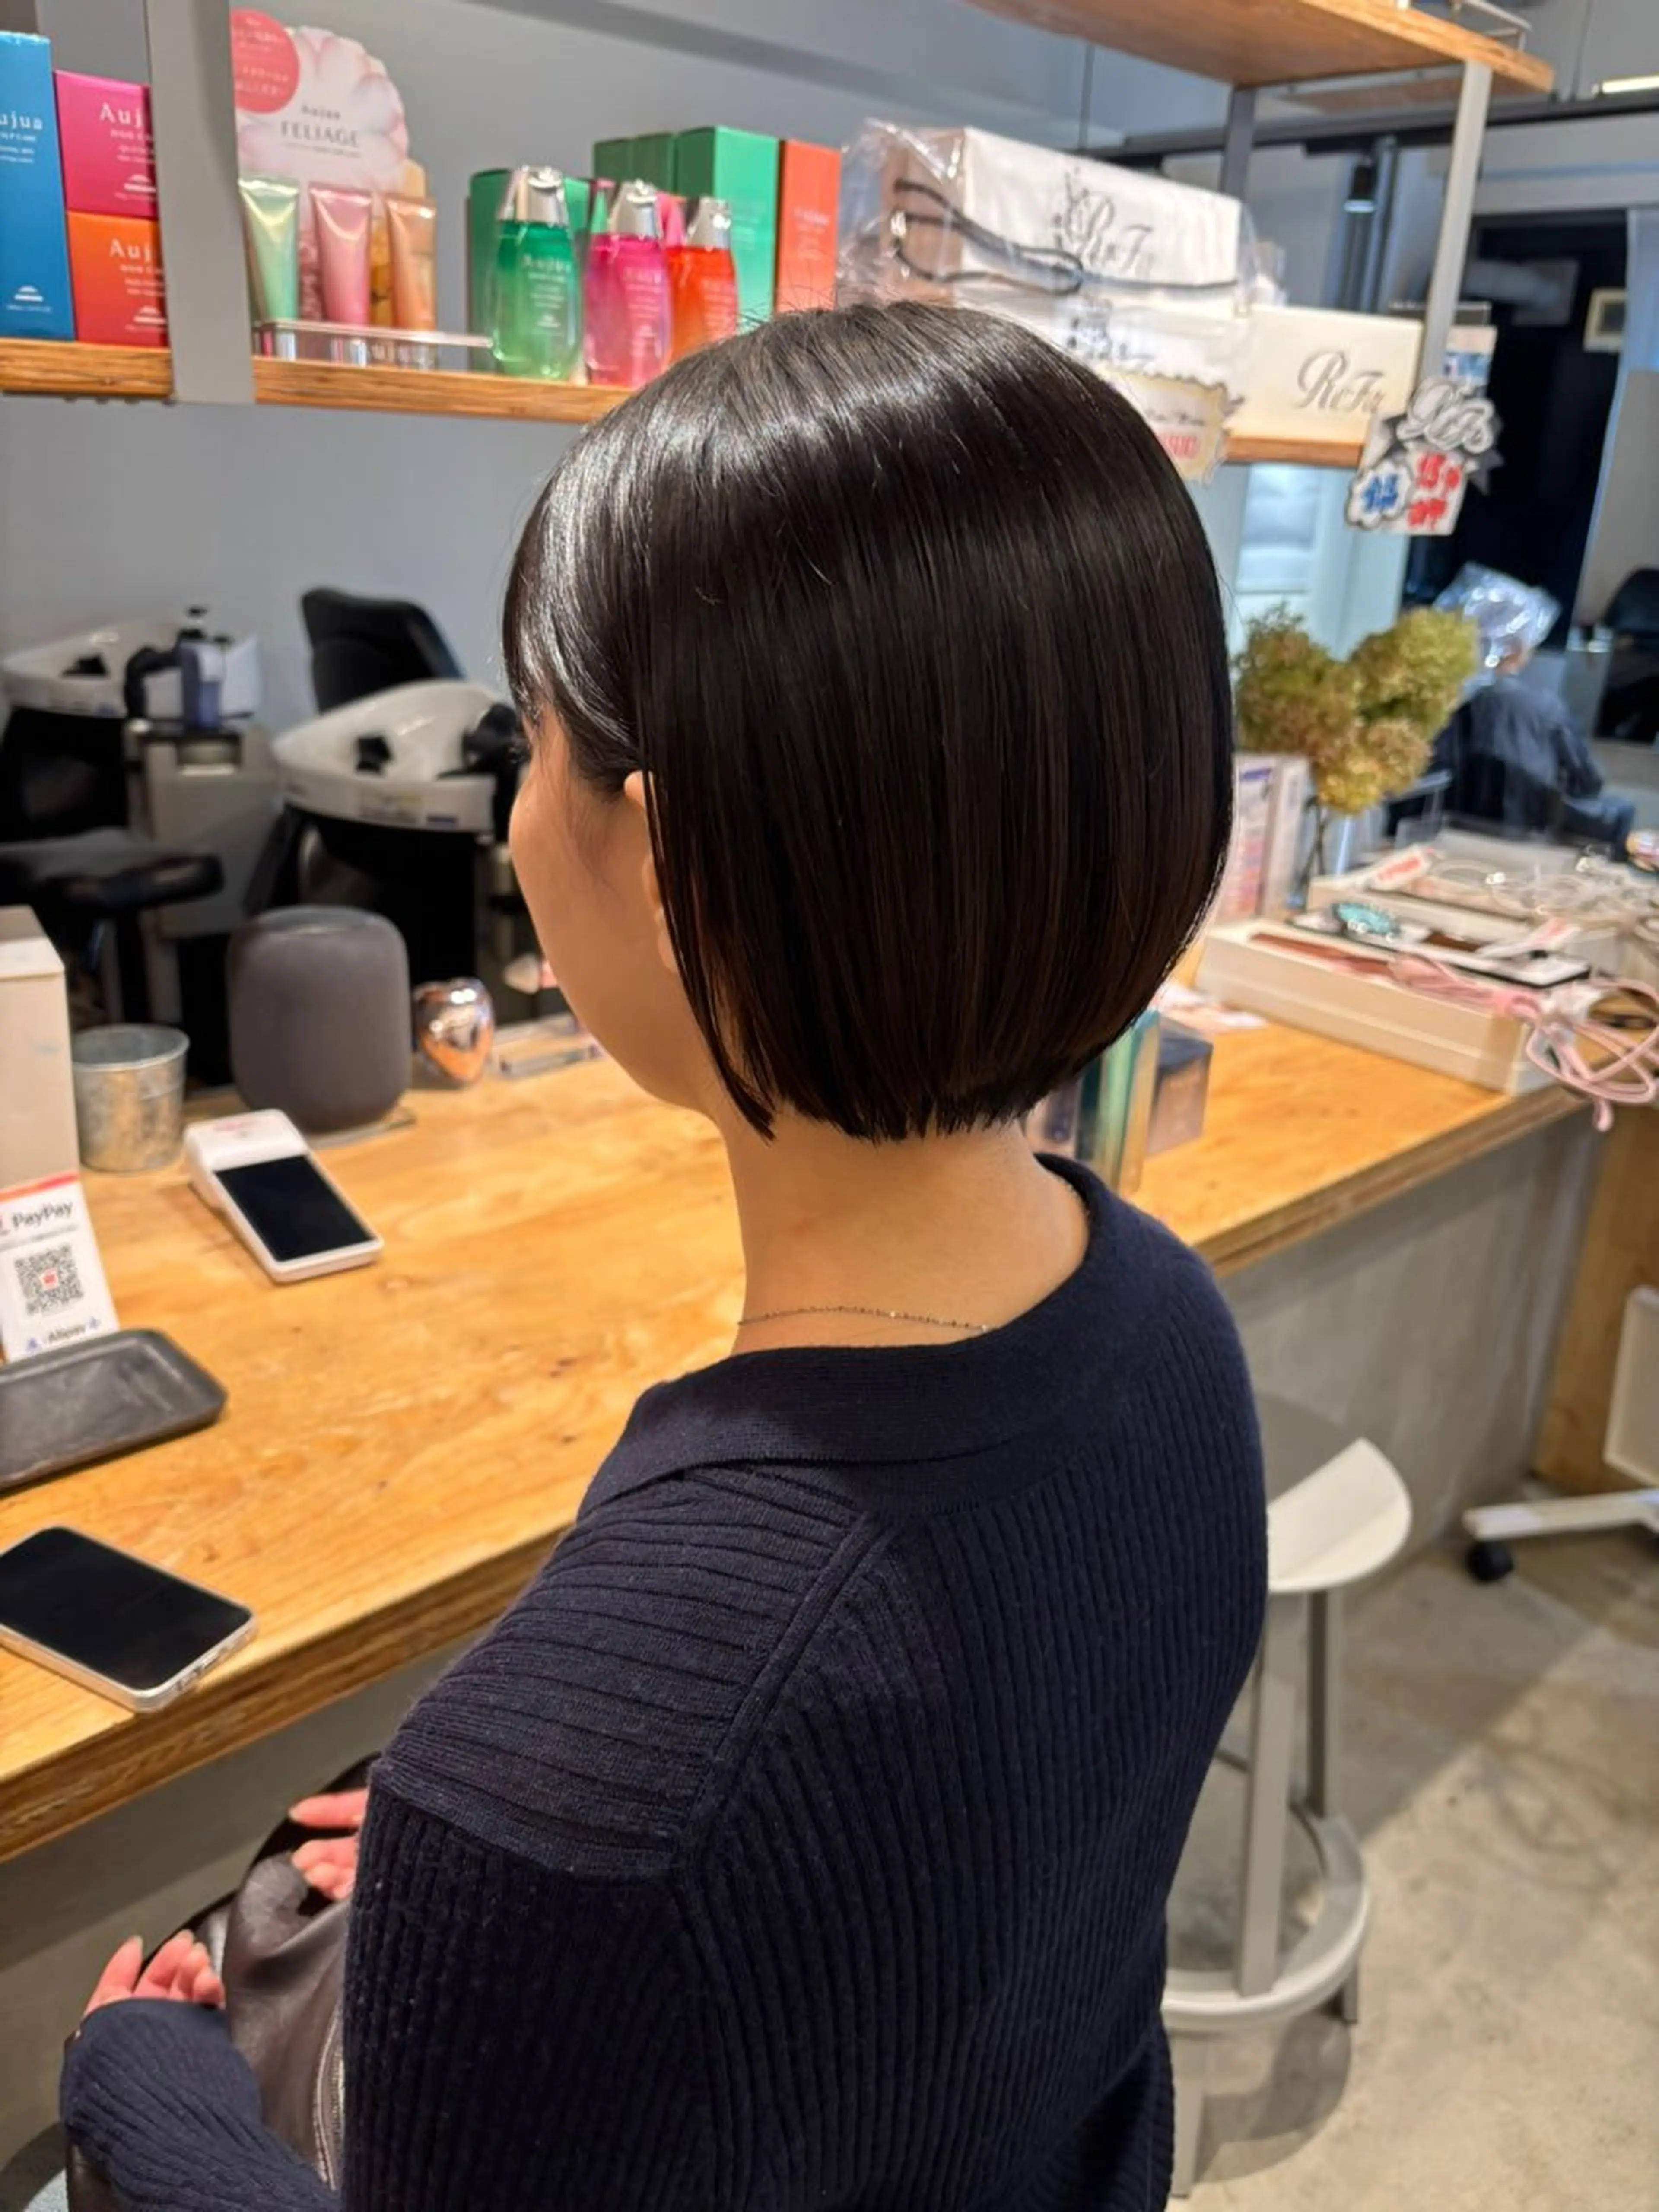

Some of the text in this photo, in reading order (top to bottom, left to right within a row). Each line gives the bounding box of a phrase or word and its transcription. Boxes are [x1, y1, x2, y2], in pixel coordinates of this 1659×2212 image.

[0, 111, 43, 130] ujua
[99, 102, 143, 129] Auj
[110, 238, 151, 263] Auj
[12, 1201, 73, 1229] PayPay
